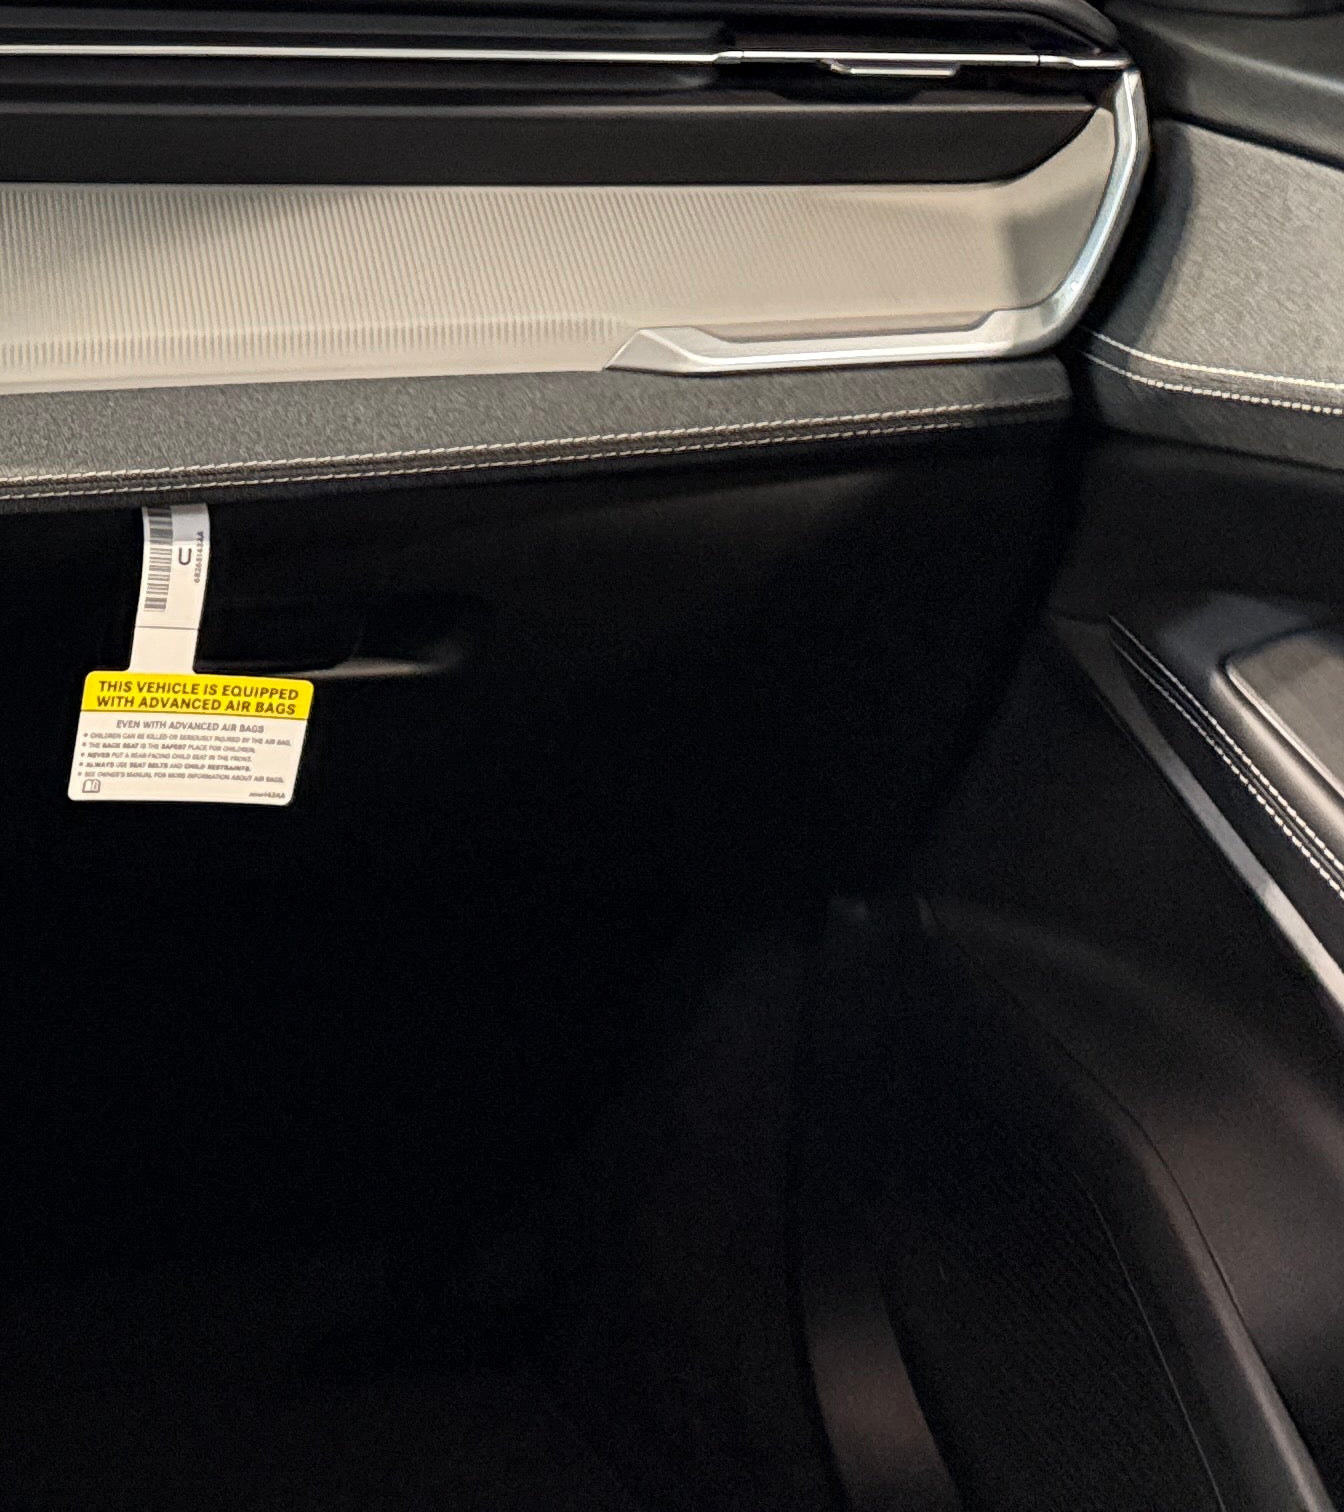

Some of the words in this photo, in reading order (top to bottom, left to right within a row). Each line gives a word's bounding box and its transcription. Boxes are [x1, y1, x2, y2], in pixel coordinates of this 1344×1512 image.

[178, 548, 192, 565] U
[99, 680, 133, 693] THIS
[137, 681, 200, 695] VEHICLE
[204, 683, 218, 695] IS
[222, 685, 298, 700] EQUIPPED
[97, 695, 135, 707] WITH
[138, 696, 221, 710] ADVANCED
[224, 700, 251, 712] AIR
[255, 702, 296, 715] BAGS
[116, 720, 140, 728] EVEN
[143, 721, 166, 729] WITH
[168, 721, 219, 731] ADVANCED
[221, 724, 237, 732] AIR
[239, 724, 264, 733] BAGS
